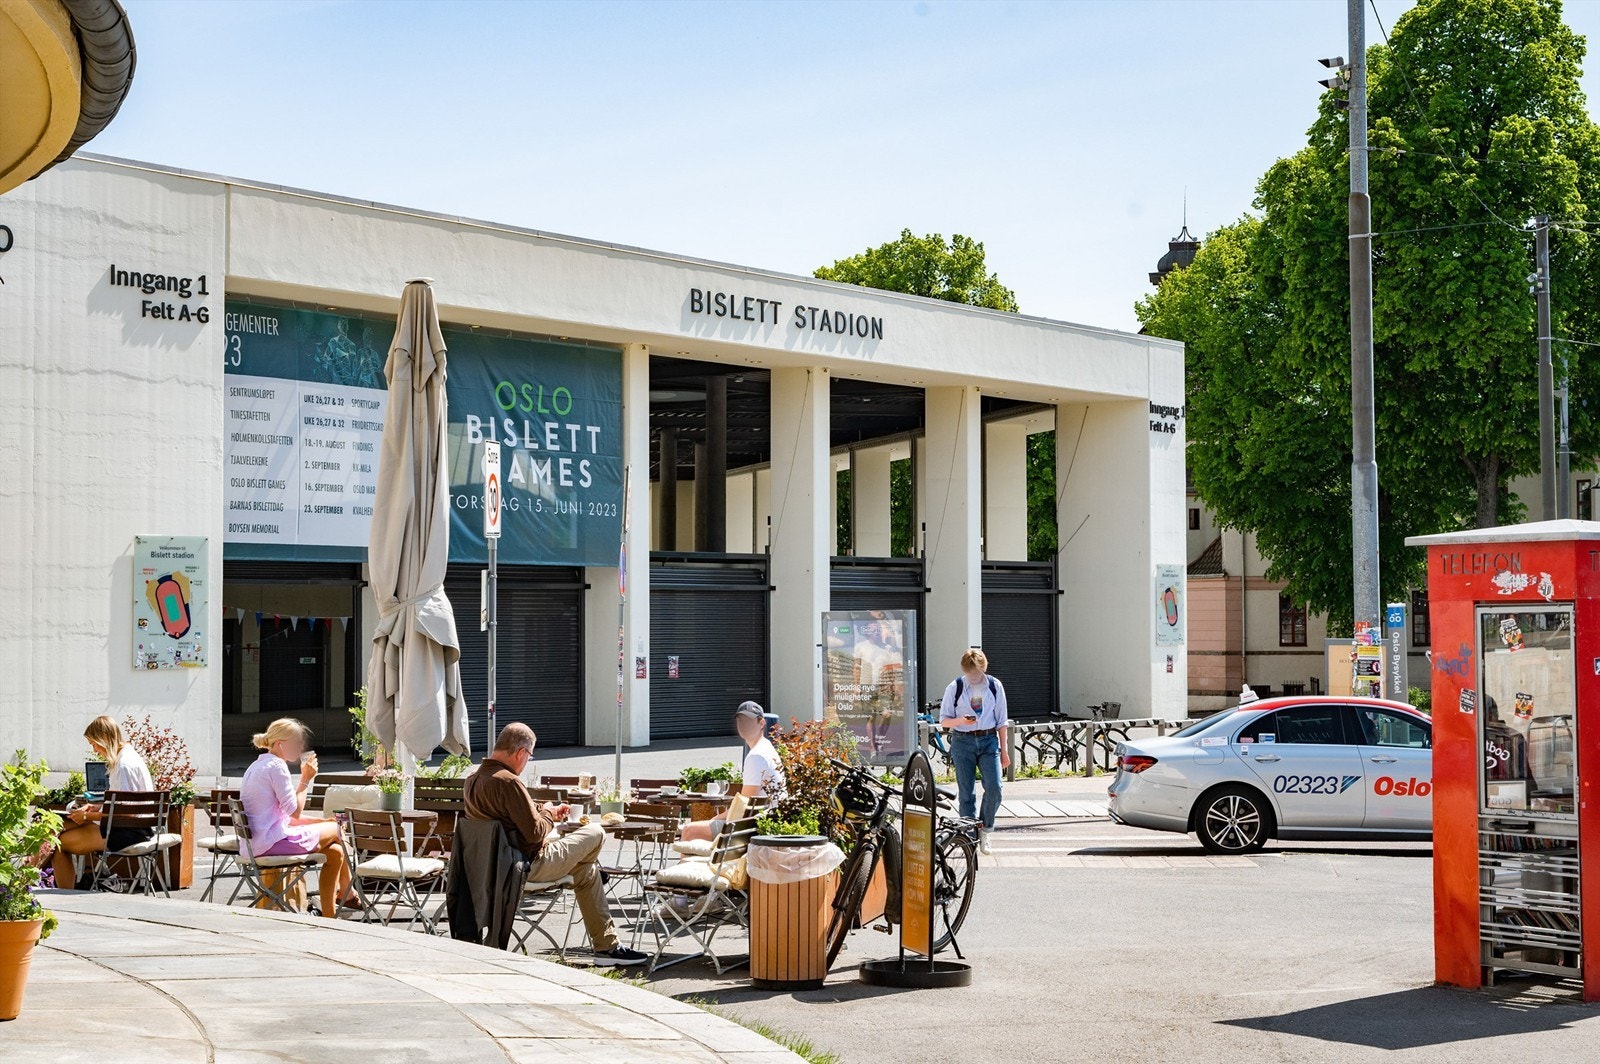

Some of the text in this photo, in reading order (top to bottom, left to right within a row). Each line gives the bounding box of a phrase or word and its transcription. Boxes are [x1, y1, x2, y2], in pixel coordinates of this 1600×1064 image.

[110, 263, 209, 299] Inngang 1
[141, 300, 209, 324] Felt A-G
[690, 287, 883, 340] BISLETT STADION
[229, 386, 275, 400] SENTRUMSLØPET
[494, 380, 573, 416] OSLO
[304, 394, 314, 403] UKE
[332, 397, 336, 405] &
[337, 398, 344, 406] 32
[230, 409, 271, 422] TINESTAFETTEN
[304, 416, 315, 425] UKE
[332, 419, 336, 427] &
[337, 420, 344, 428] 32
[230, 432, 293, 446] HOLMENKOLLSTAFETTEN
[466, 414, 601, 454] BISLETT
[325, 440, 346, 450] AUGUST
[311, 461, 340, 471] SEPTEMBER
[480, 453, 593, 489] AMES
[230, 477, 286, 490] OSLO BISLETT GAMES
[304, 483, 344, 493] 16. SEPTEMBER
[229, 500, 284, 512] BARNAS BISLETTDAG
[303, 505, 344, 515] 23. SEPTEMBER
[527, 498, 548, 513] 15.
[553, 502, 582, 515] JUNI
[588, 503, 617, 517] 2023
[228, 523, 280, 534] BOYSEN MEMORIAL
[150, 551, 195, 559] Bislett stadion
[1440, 552, 1522, 575] TELEFON
[1391, 632, 1402, 694] Oslo Bysykkel
[834, 683, 875, 692] Oppdag nye
[834, 692, 872, 703] muligheter
[837, 702, 854, 711] Oslo
[1273, 775, 1432, 797] 02323 Oslo
